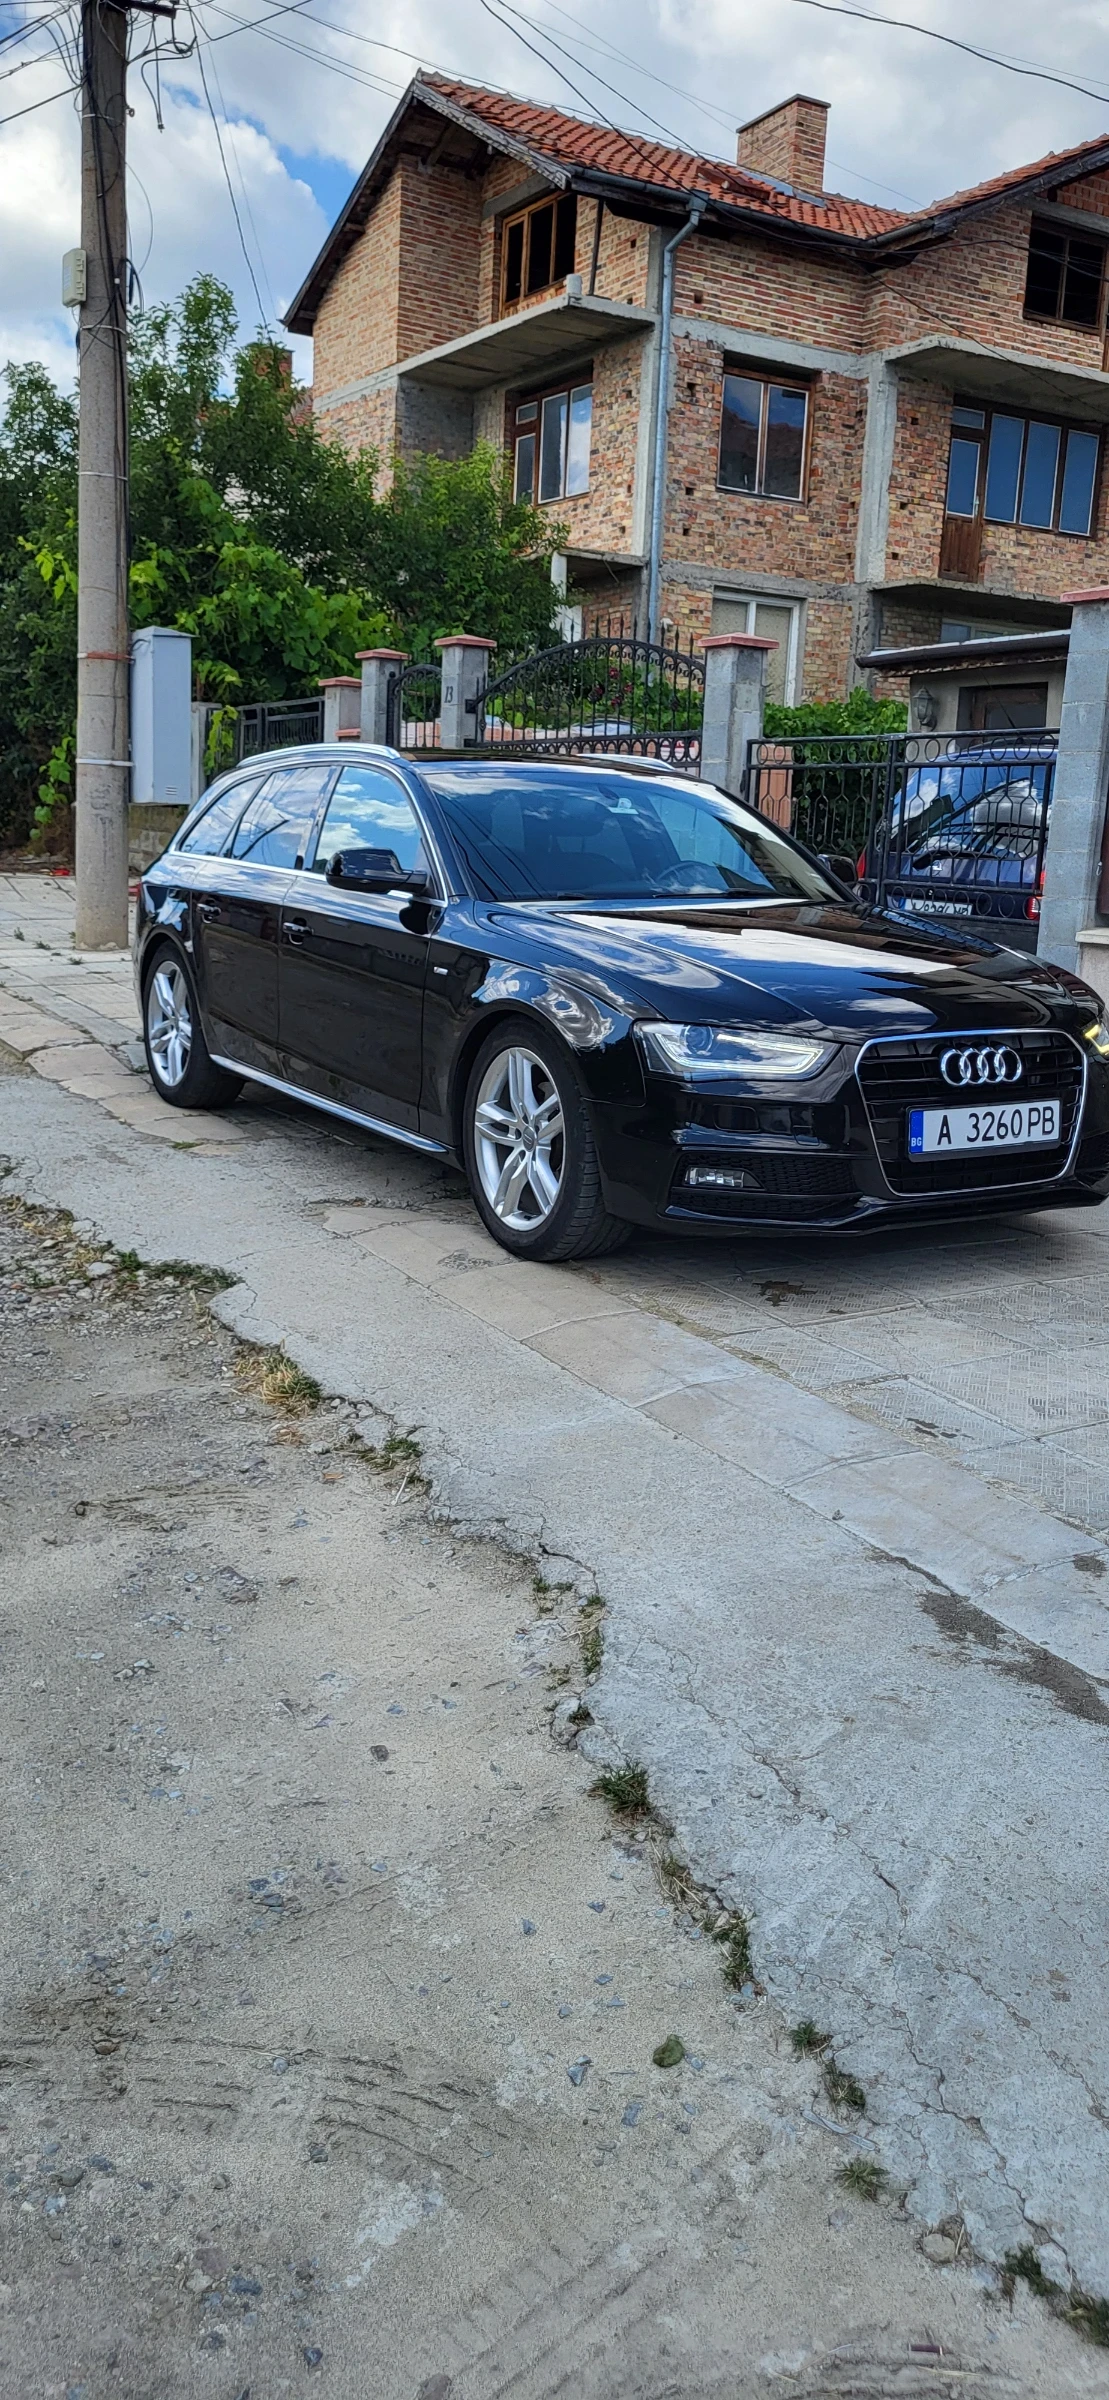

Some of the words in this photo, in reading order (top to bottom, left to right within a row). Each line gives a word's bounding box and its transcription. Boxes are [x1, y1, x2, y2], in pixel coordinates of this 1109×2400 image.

[444, 686, 454, 703] 13
[937, 1114, 952, 1146] A
[911, 1137, 922, 1147] BG
